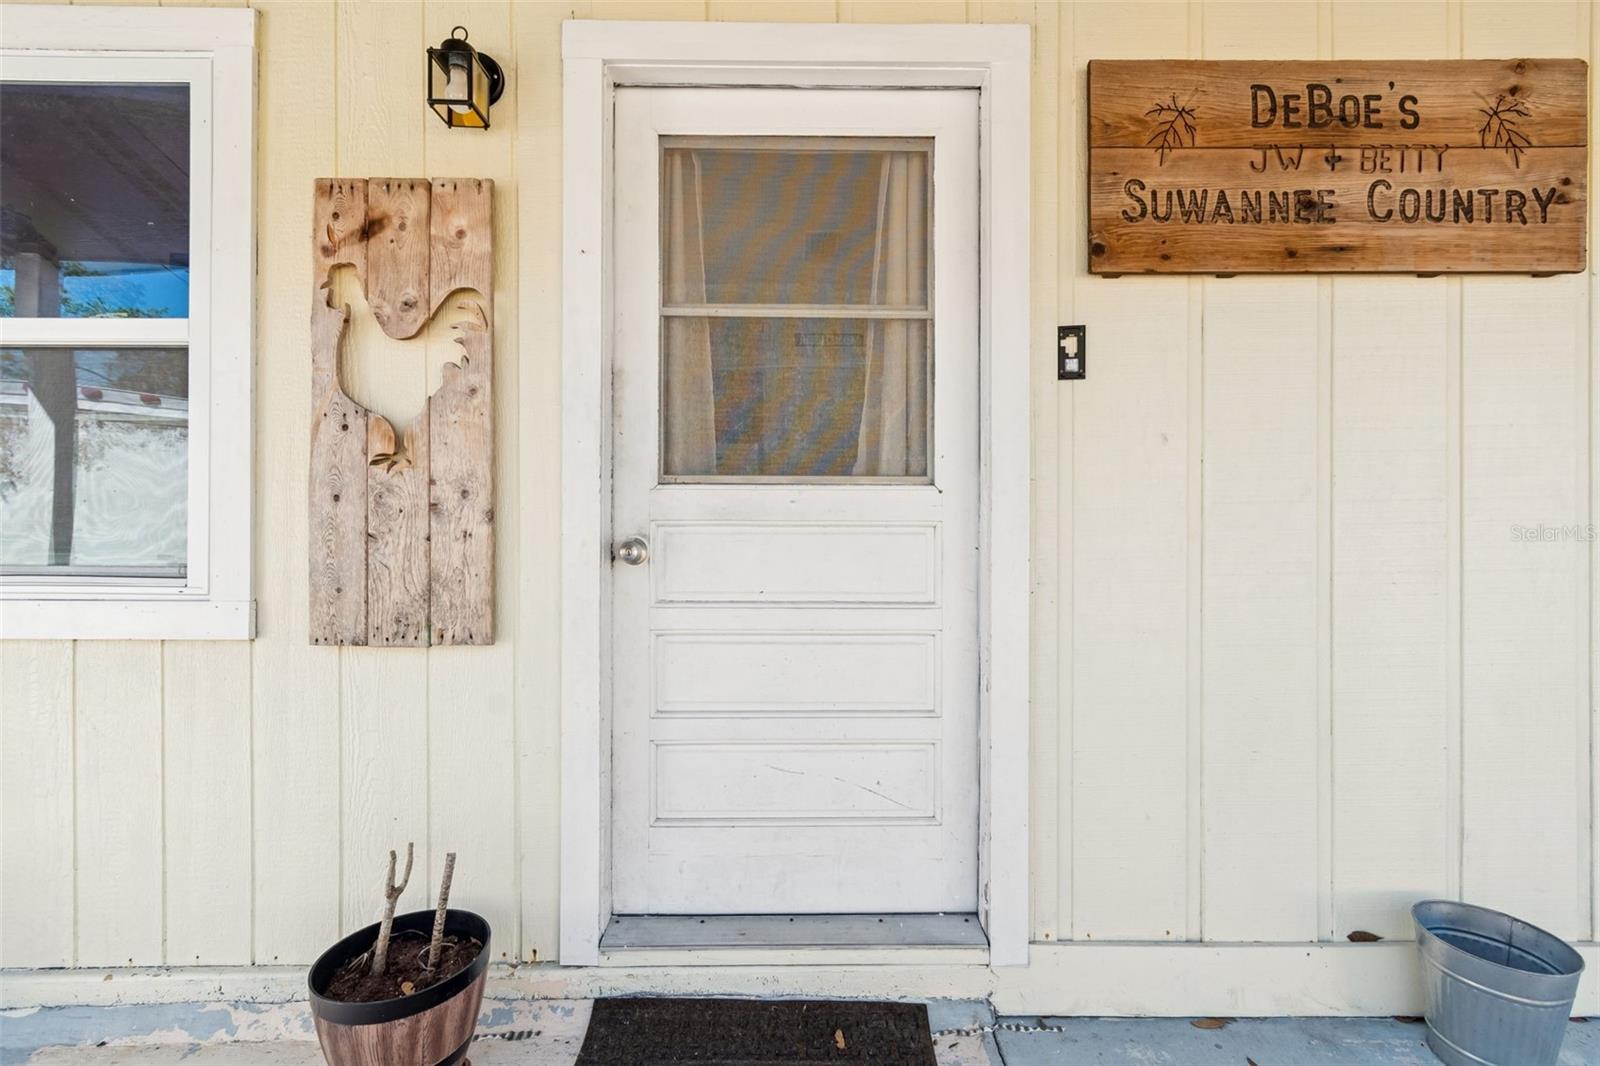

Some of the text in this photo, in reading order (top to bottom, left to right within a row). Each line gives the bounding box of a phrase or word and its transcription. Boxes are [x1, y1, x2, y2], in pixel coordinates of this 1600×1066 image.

[1249, 144, 1304, 173] JW
[1360, 144, 1449, 173] BETTY
[1121, 178, 1556, 225] SUWANNEE COUNTRY
